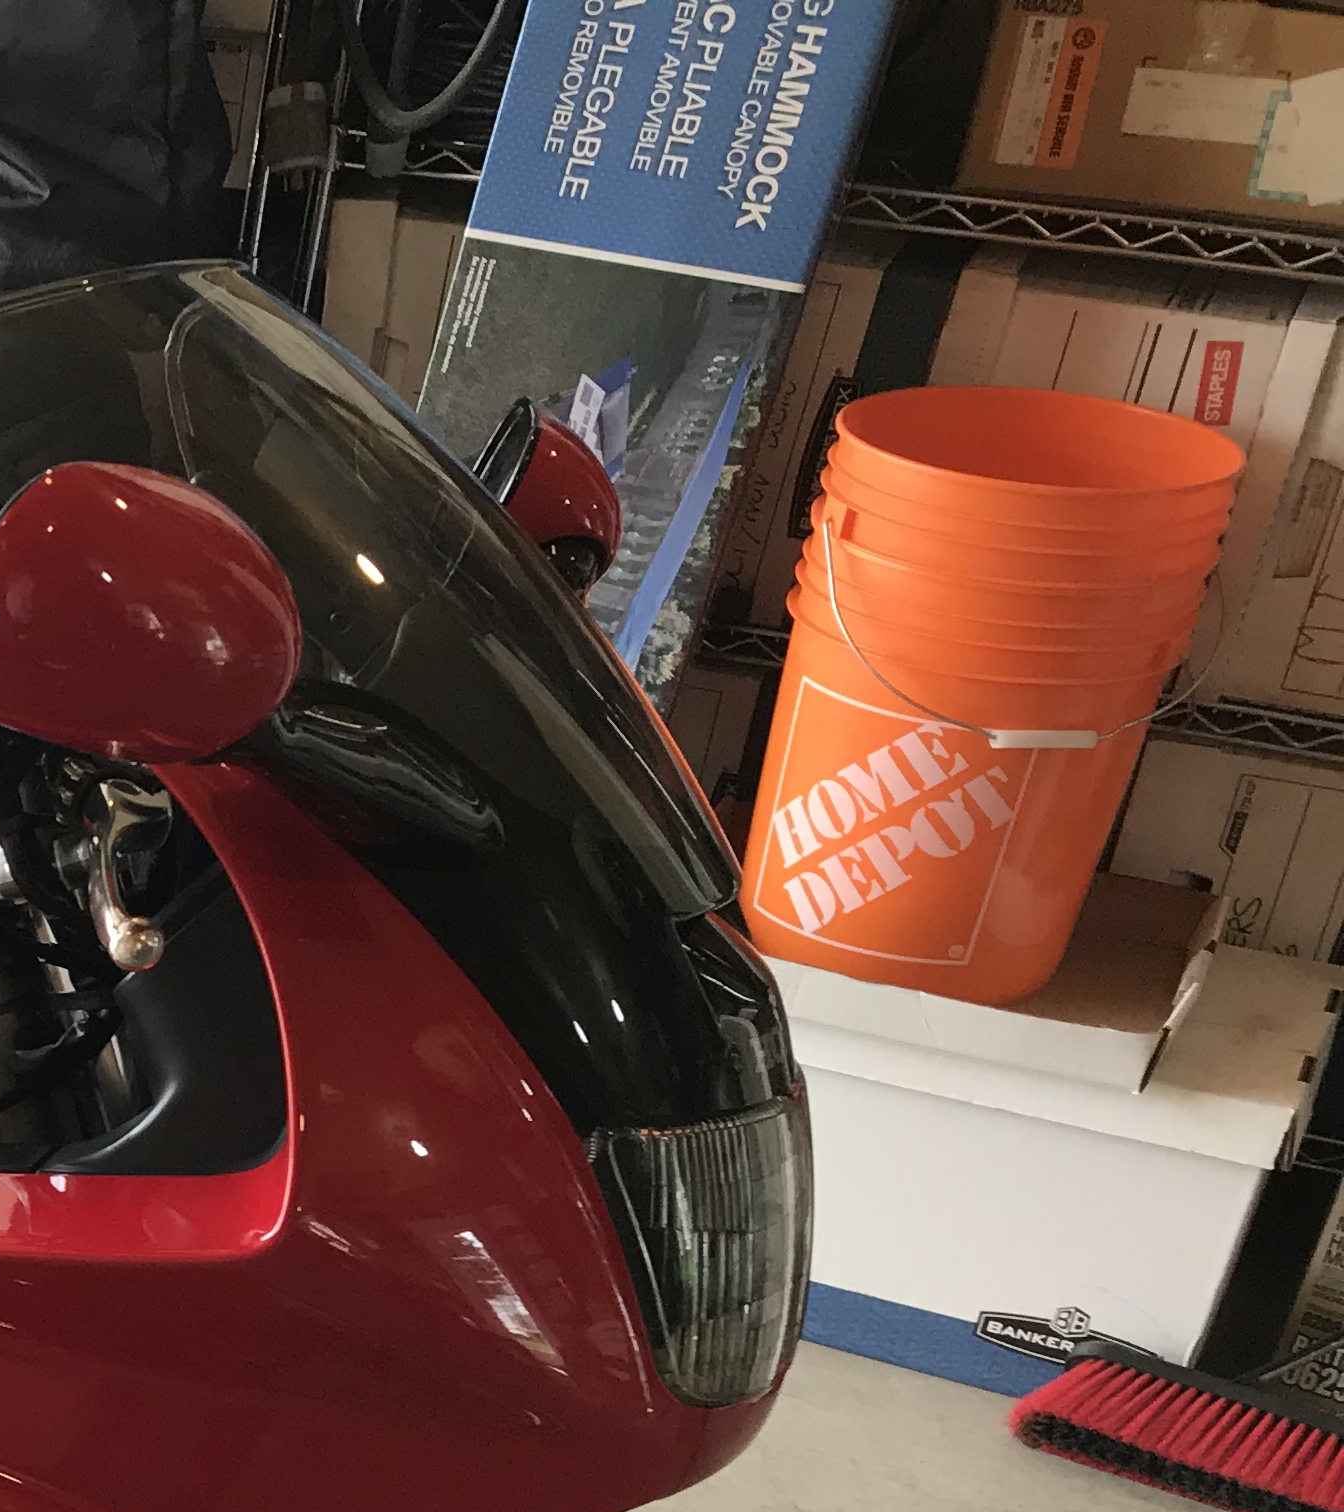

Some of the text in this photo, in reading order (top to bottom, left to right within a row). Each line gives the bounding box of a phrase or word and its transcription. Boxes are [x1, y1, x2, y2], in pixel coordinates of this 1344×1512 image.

[543, 19, 598, 154] REMOVIBLE
[558, 21, 636, 200] PLEGABLE
[630, 52, 681, 172] AMOVIBLE
[657, 39, 723, 179] PLIABLE
[717, 0, 793, 199] OVABLE CANOPY
[735, 25, 828, 231] HAMMOCK
[1204, 348, 1232, 422] STAPLES
[772, 720, 970, 870] HOME
[783, 764, 1014, 936] DEPOT
[985, 1319, 1076, 1354] BANKER
